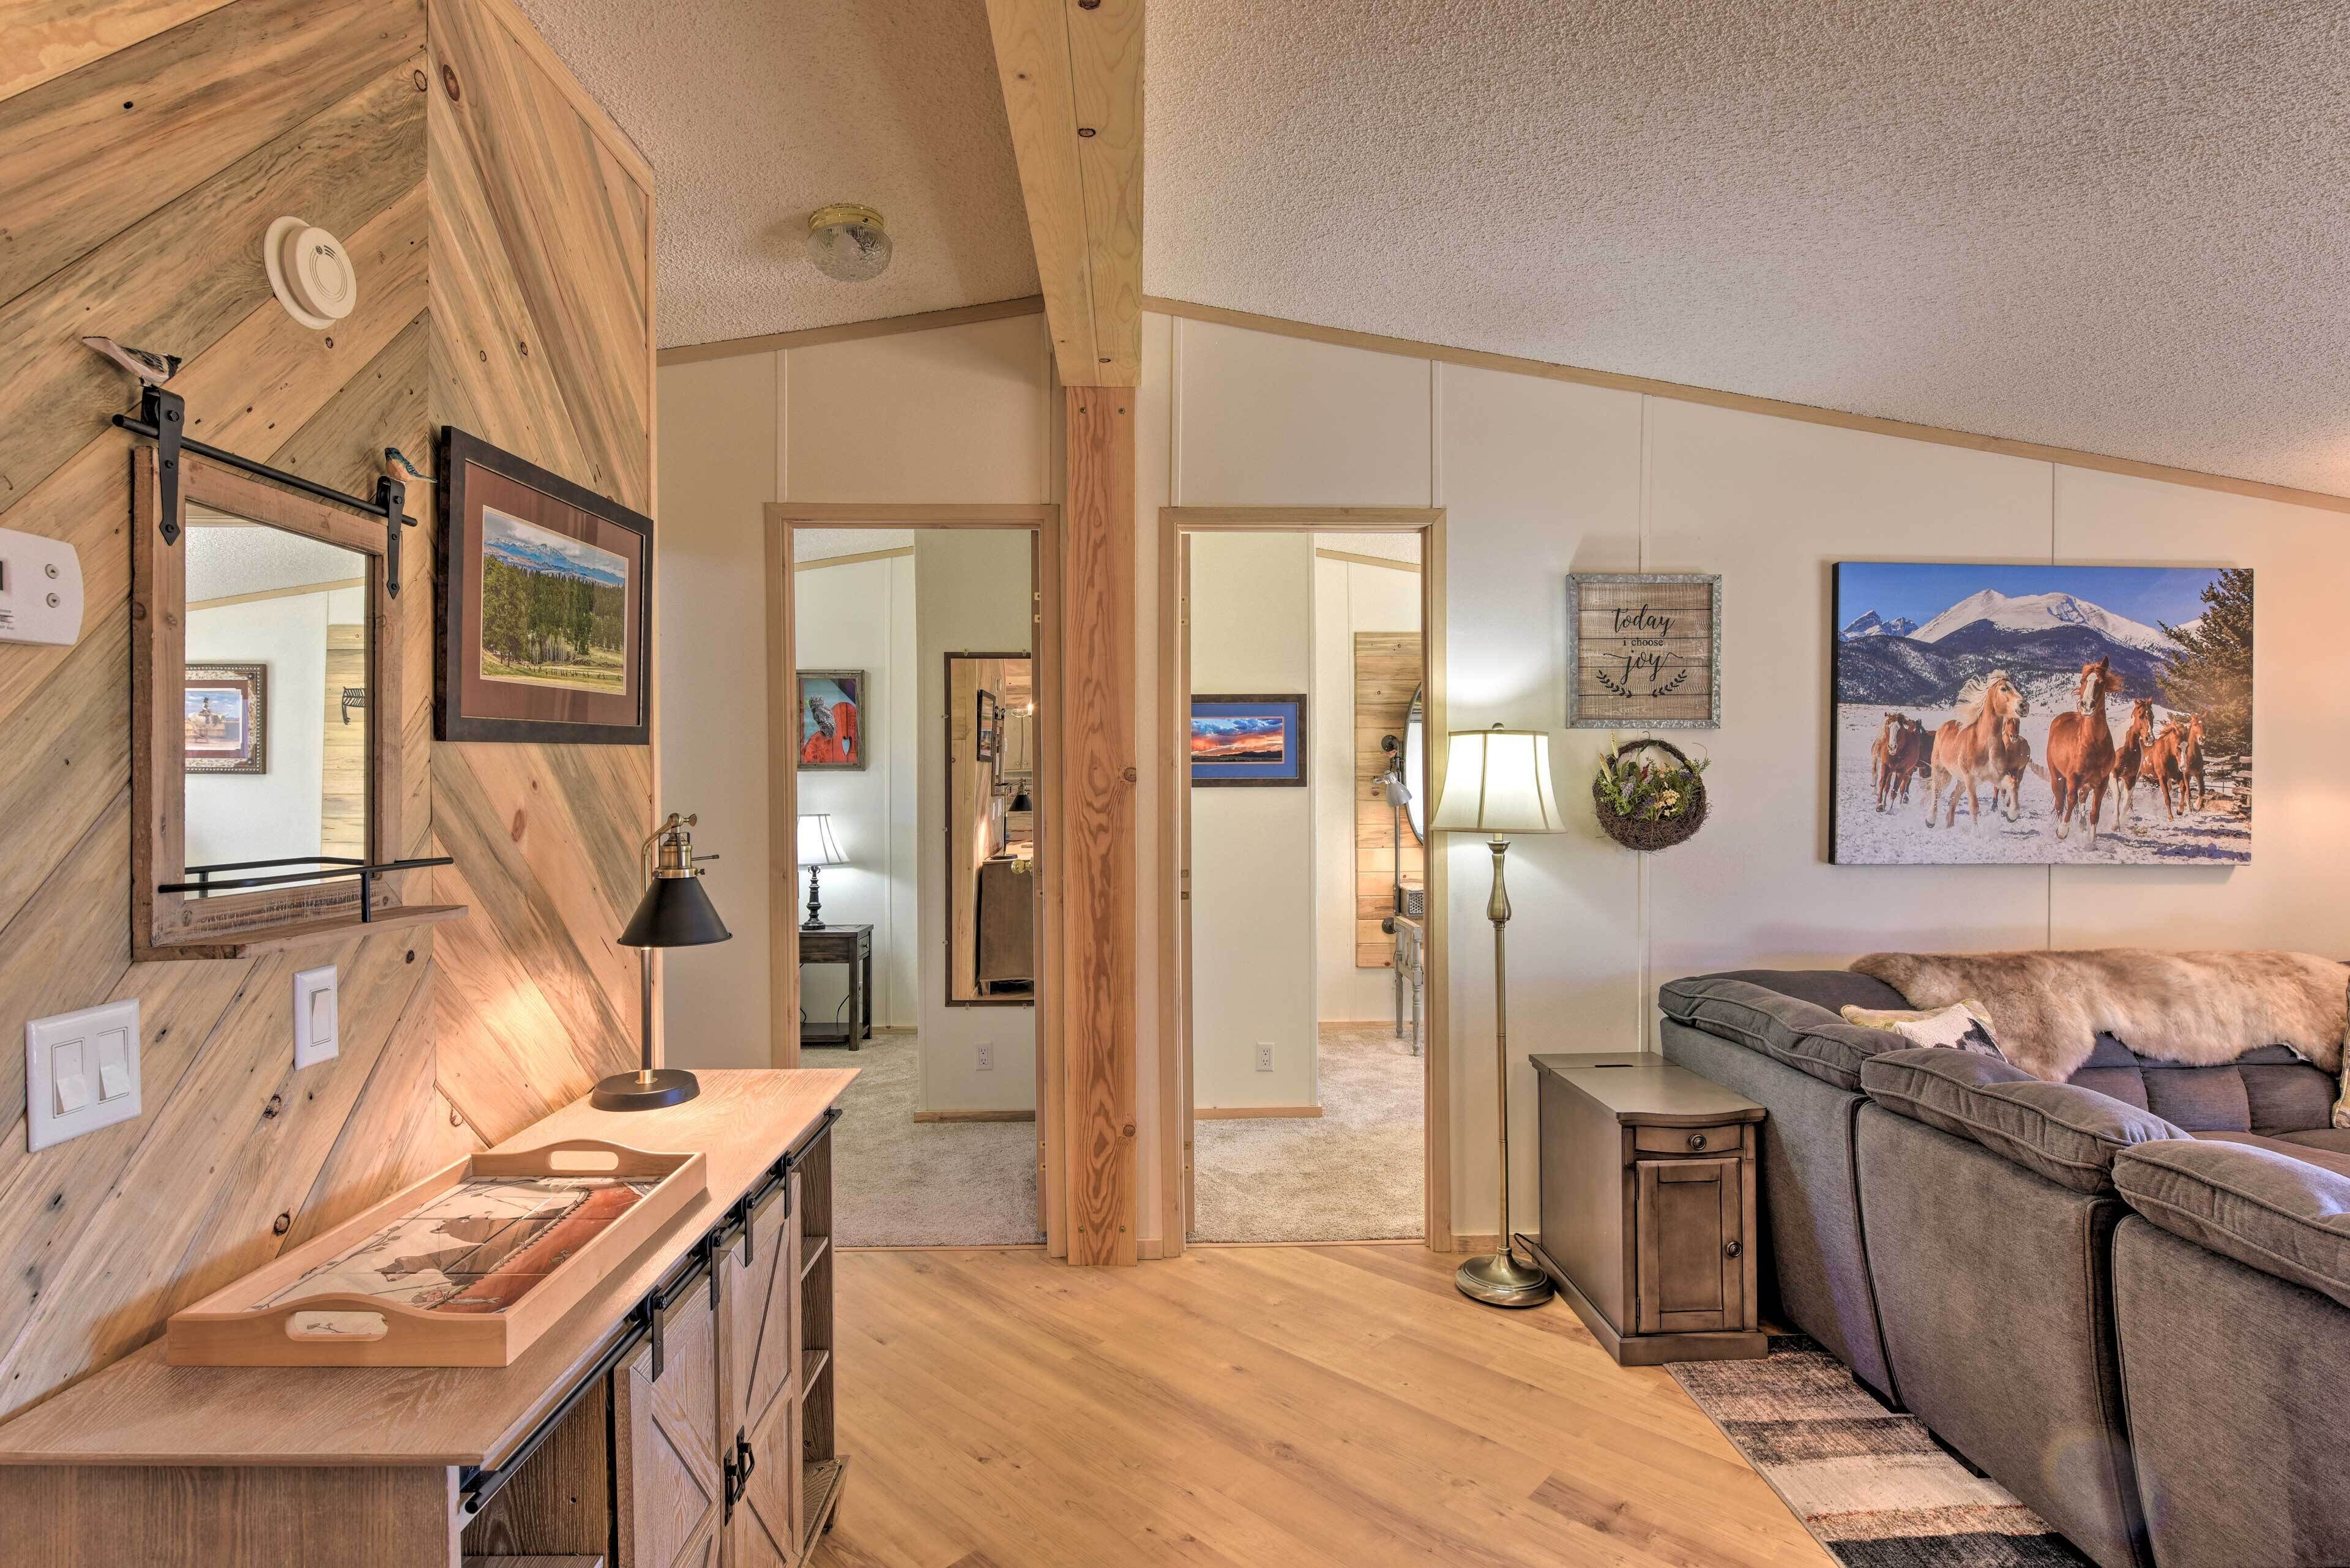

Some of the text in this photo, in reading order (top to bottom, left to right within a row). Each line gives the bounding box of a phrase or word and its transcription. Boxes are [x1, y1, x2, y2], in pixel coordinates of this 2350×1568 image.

[1612, 604, 1676, 637] today
[1622, 637, 1663, 646] i choose
[1603, 651, 1683, 685] joy
